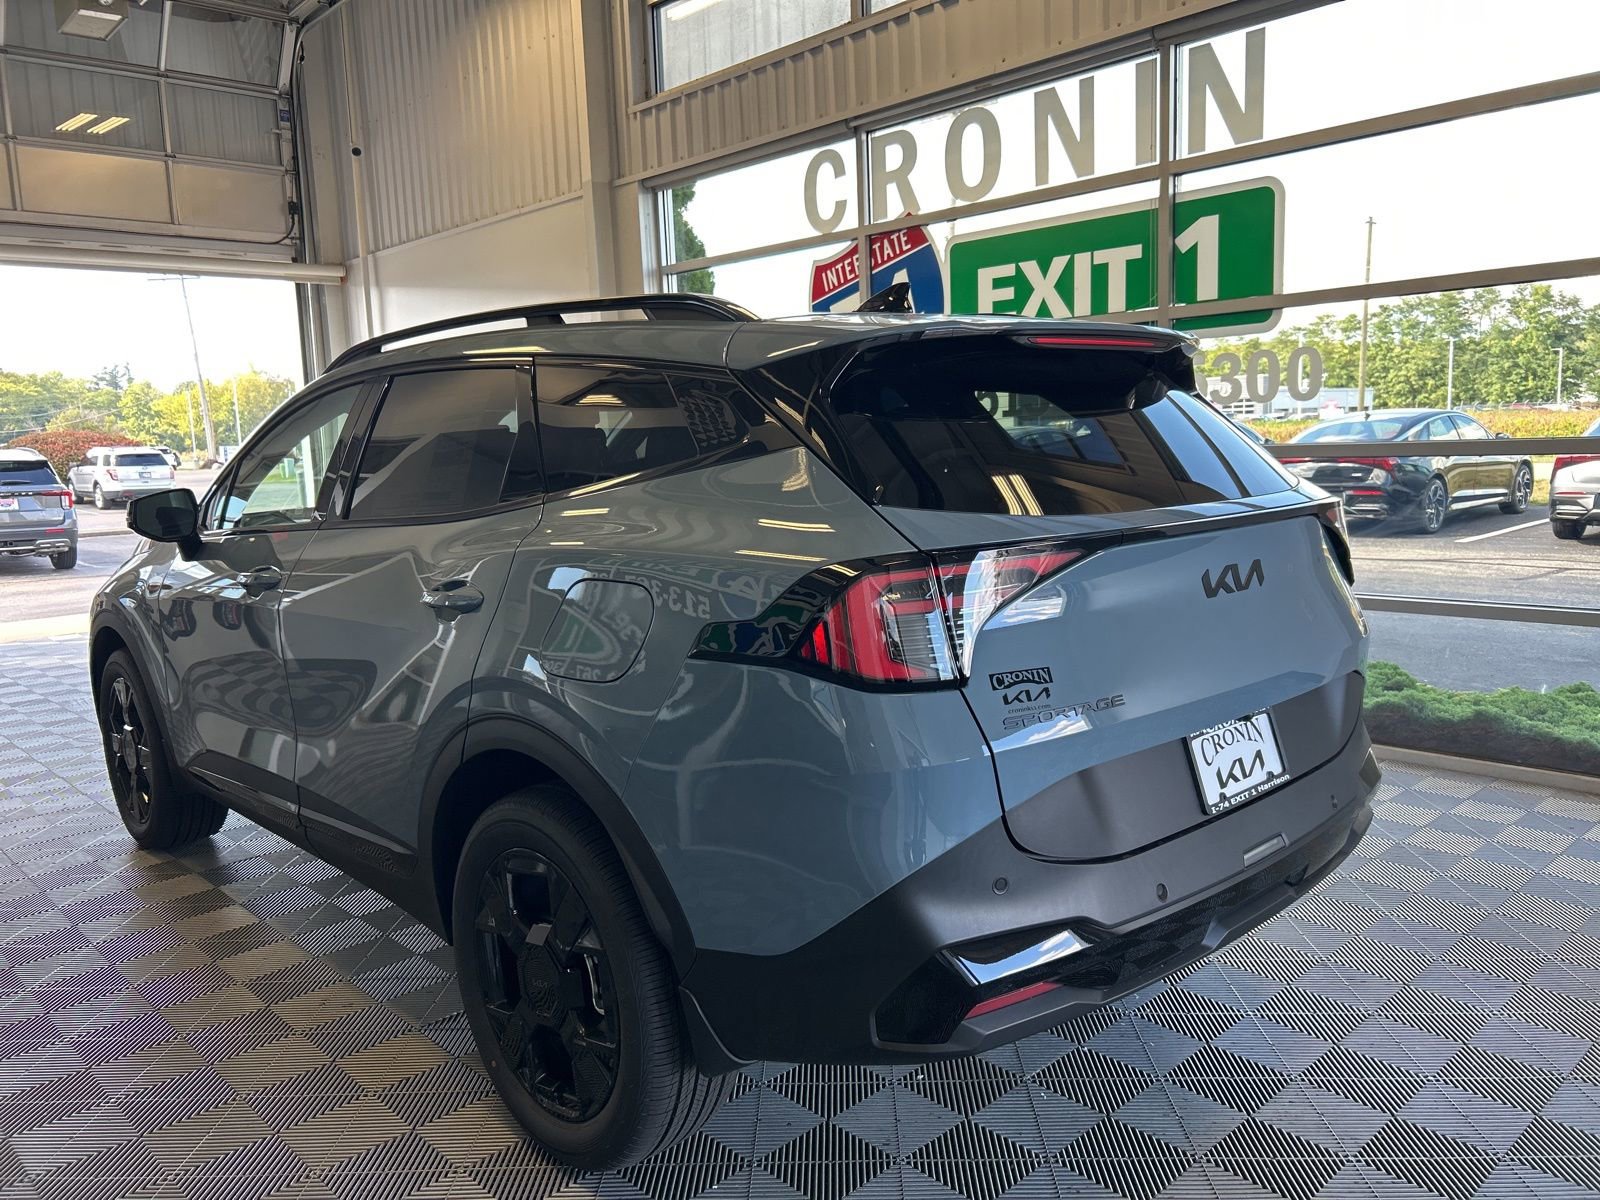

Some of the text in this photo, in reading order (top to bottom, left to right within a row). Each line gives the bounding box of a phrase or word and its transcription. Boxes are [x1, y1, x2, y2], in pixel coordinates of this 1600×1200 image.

[803, 27, 1266, 235] CRONIN
[821, 229, 911, 293] INTERTATE
[977, 243, 1143, 319] EXIT
[1174, 214, 1219, 301] 1
[1201, 559, 1265, 598] KIA
[992, 668, 1050, 690] CRONIN
[1002, 687, 1051, 705] KIA
[1002, 694, 1126, 730] SPORTAGE
[1201, 718, 1264, 766] CRONIN
[1216, 749, 1265, 790] KIA
[1211, 774, 1290, 814] I-74 EXIT 1 Harrison
